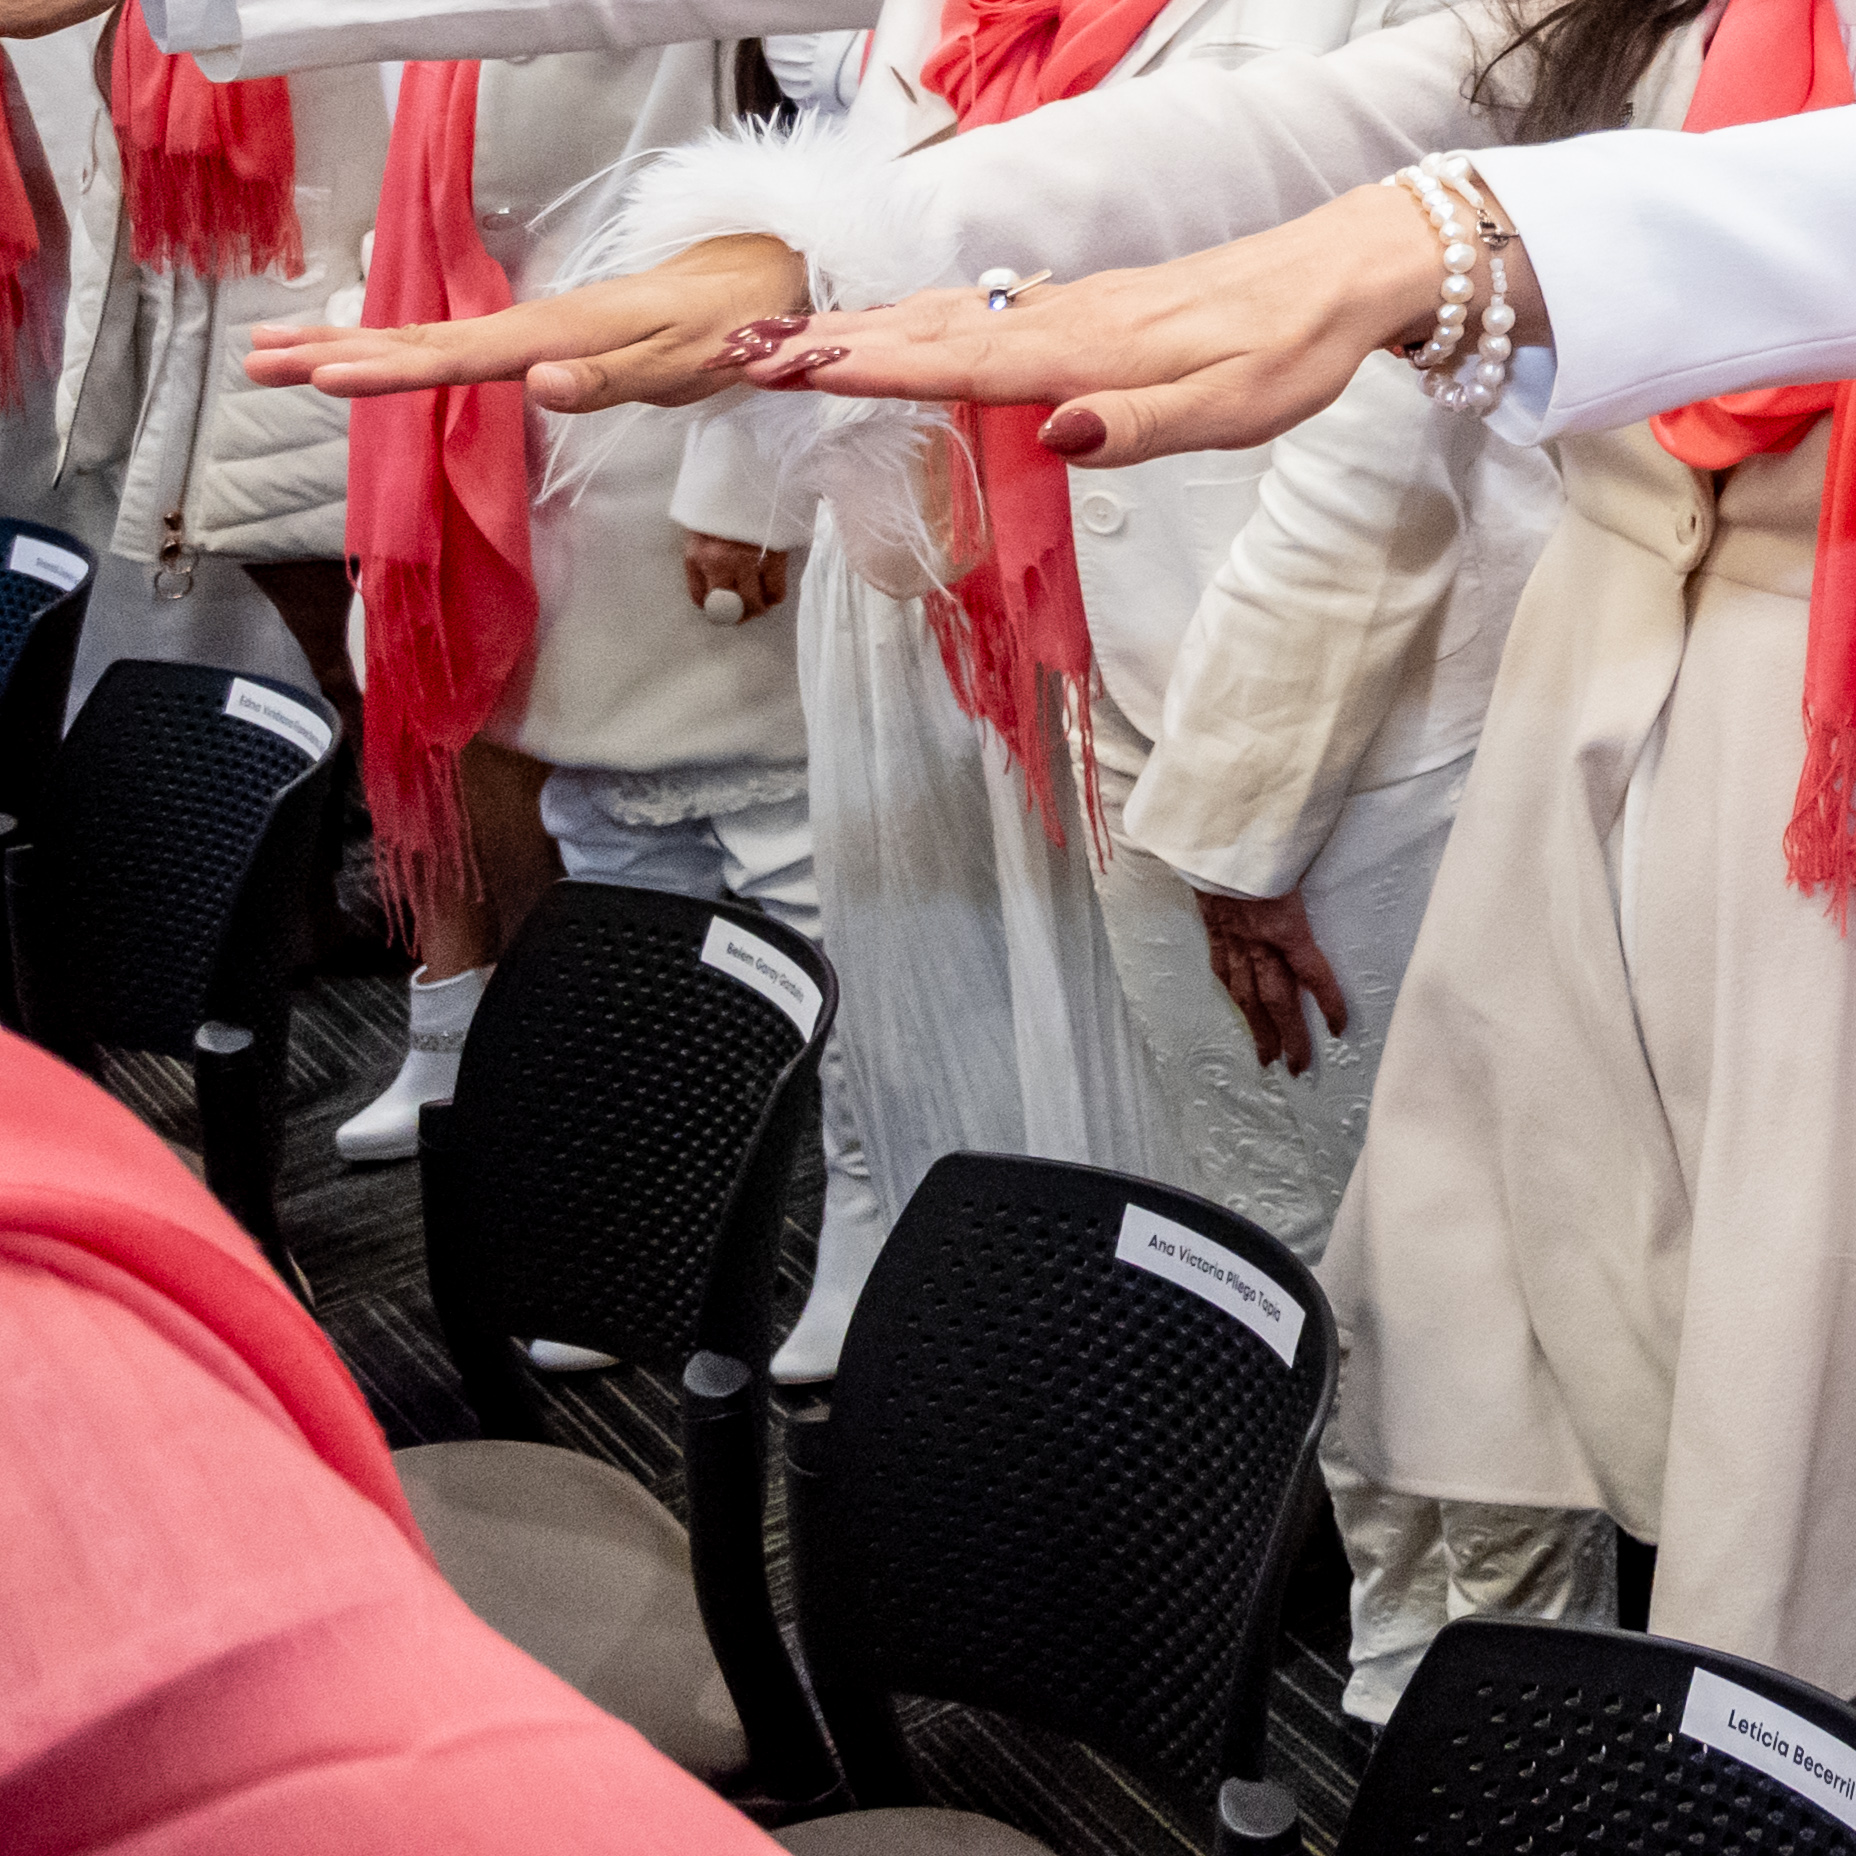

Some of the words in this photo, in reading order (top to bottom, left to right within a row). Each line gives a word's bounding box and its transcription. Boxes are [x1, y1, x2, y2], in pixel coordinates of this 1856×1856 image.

[1147, 1234, 1175, 1257] Ana
[1179, 1245, 1224, 1281] Victoria
[1226, 1270, 1257, 1302] Pliego
[1258, 1290, 1281, 1323] Tapia
[1727, 1709, 1789, 1758] Leticia
[1792, 1744, 1855, 1800] Becerril
